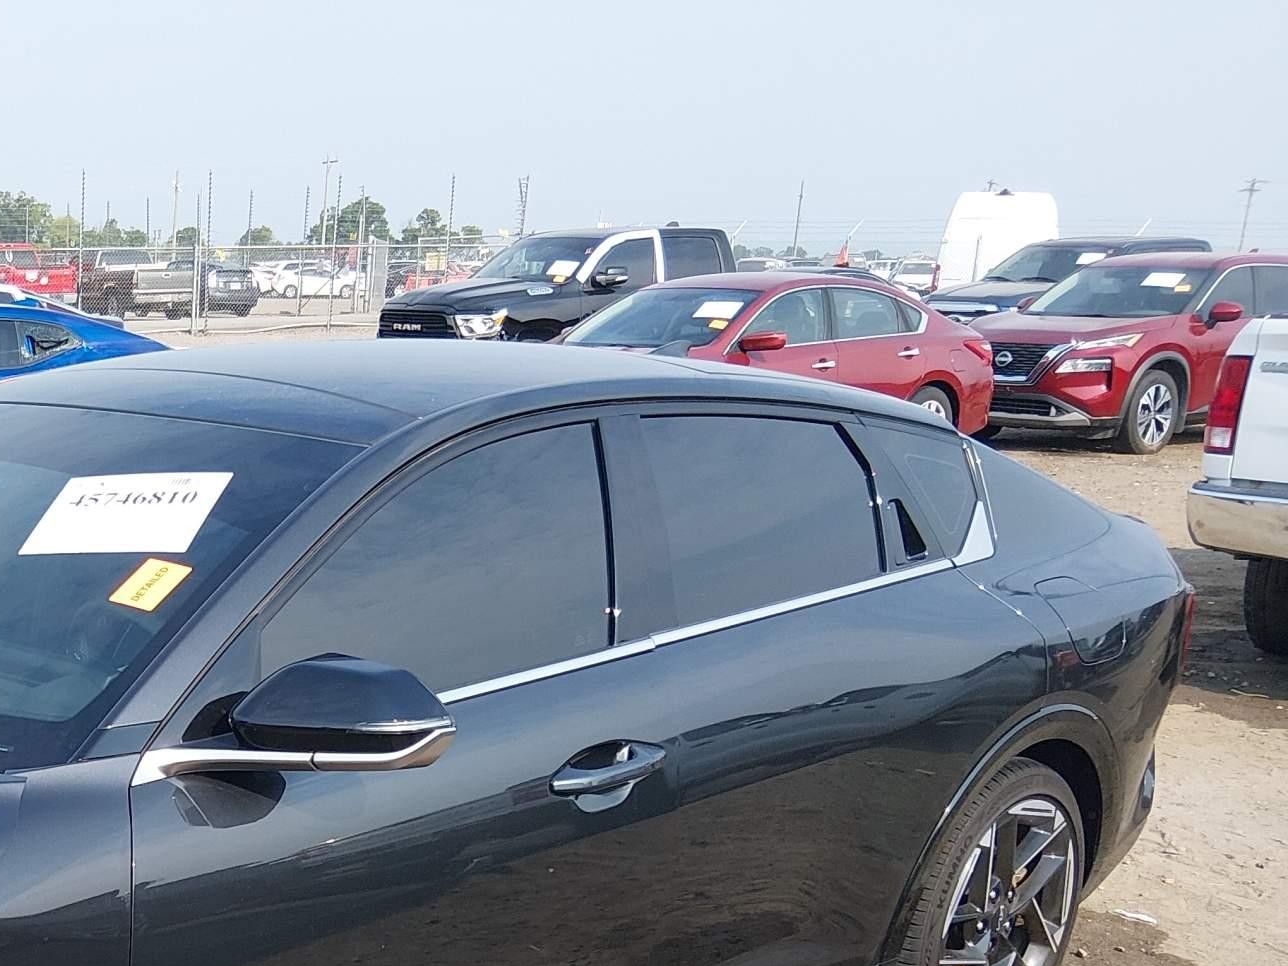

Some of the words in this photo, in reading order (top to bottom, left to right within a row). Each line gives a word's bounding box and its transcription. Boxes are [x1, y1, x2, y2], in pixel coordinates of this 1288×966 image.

[393, 323, 422, 331] RAM
[69, 490, 198, 507] 45746810
[130, 566, 169, 602] DETAILED
[936, 835, 973, 909] KUMHO
